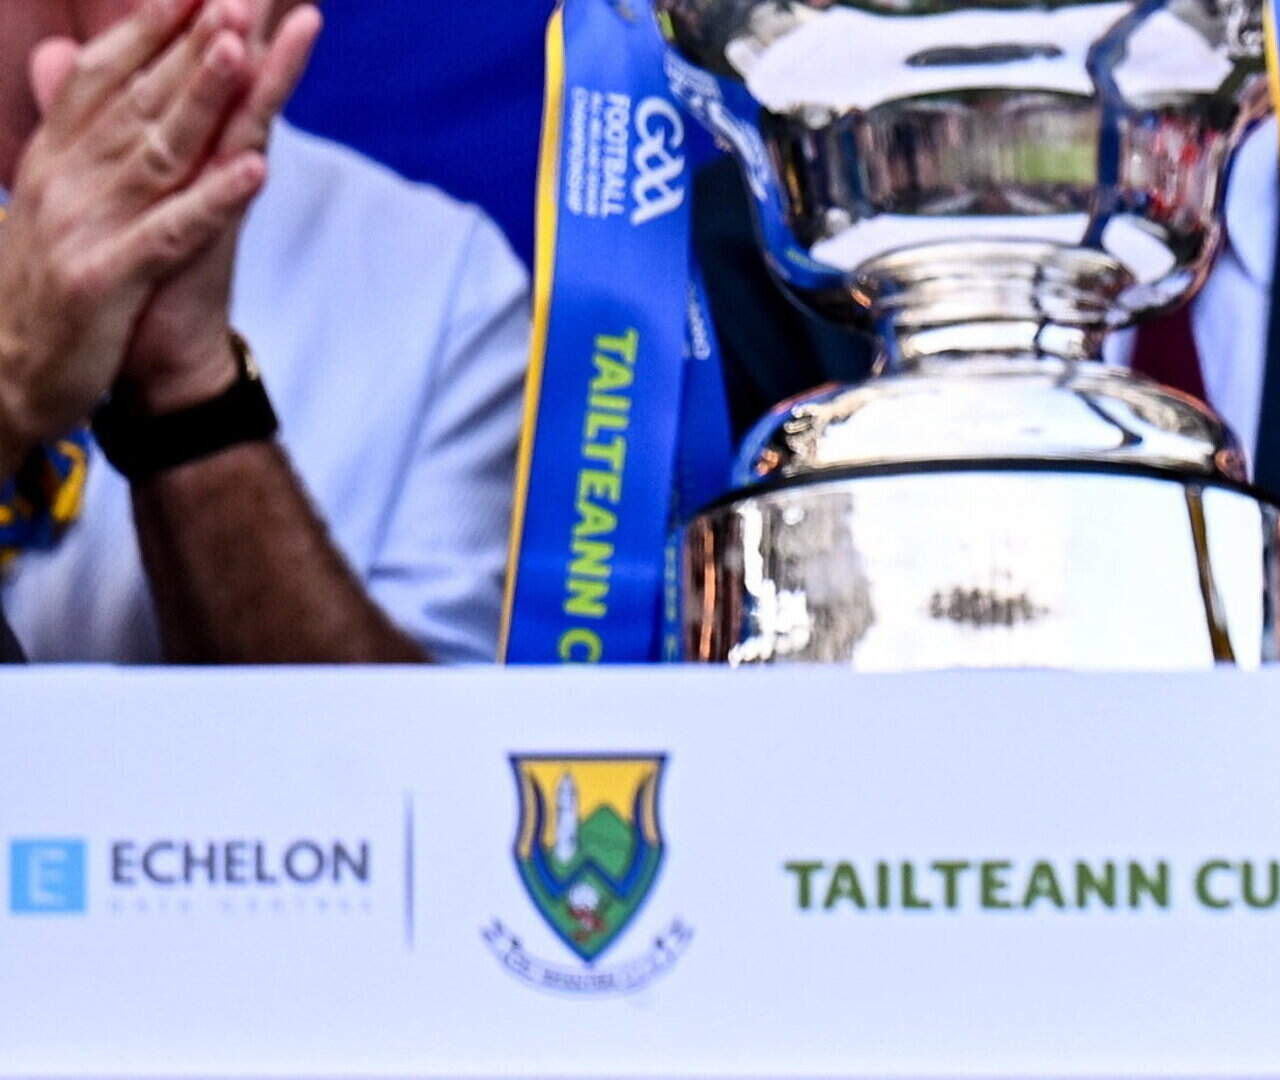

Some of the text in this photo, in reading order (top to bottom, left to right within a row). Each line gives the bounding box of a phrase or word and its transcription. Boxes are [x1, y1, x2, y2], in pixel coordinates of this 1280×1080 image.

[600, 92, 631, 219] FOOTBALL
[562, 327, 639, 619] TAILTEANN
[111, 839, 369, 885] ECHELON
[783, 859, 1169, 910] TAILTEANN
